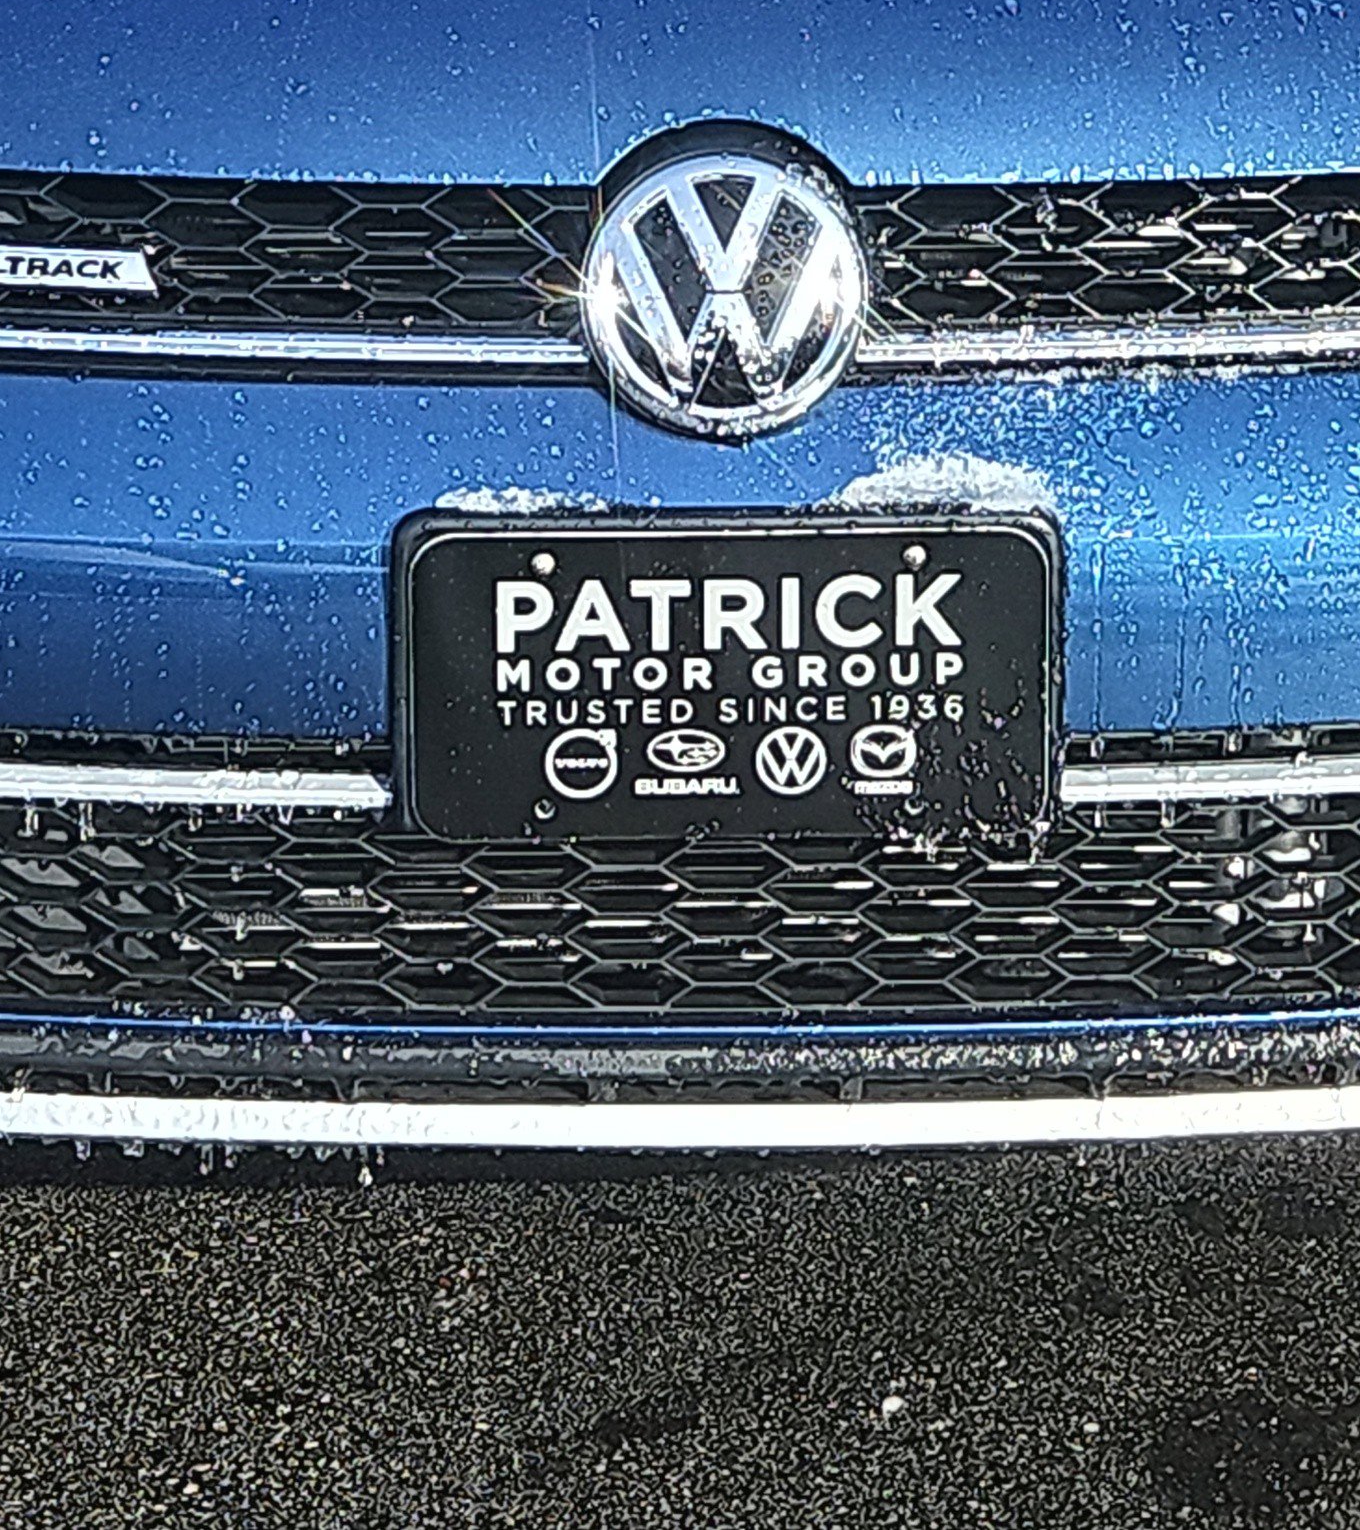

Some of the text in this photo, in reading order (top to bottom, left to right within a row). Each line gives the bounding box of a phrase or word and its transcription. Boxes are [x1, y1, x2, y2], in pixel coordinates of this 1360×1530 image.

[494, 572, 963, 654] PATRICK
[496, 652, 965, 693] MOTOR GROUP
[497, 694, 965, 727] TRUSTED SINCE 1936
[634, 777, 737, 795] SUBARU
